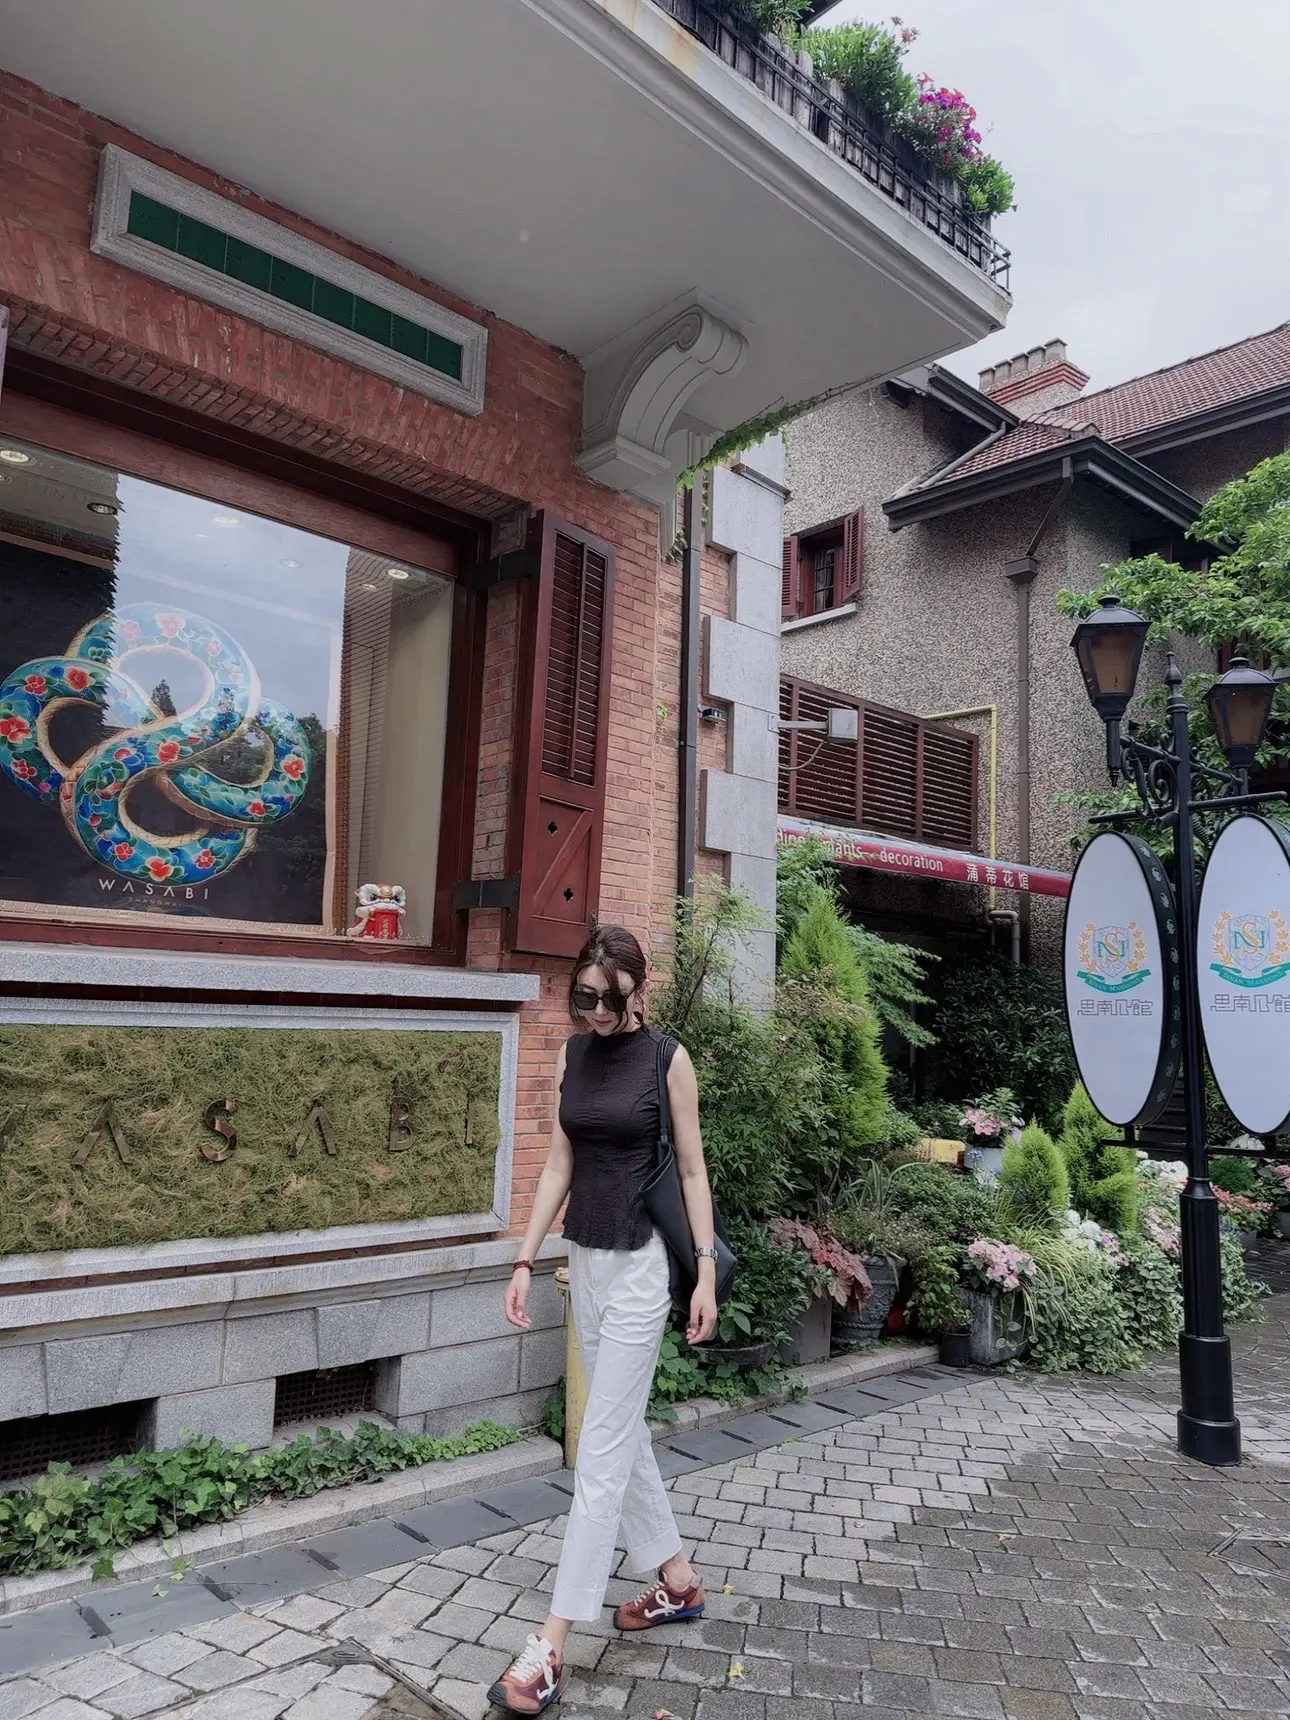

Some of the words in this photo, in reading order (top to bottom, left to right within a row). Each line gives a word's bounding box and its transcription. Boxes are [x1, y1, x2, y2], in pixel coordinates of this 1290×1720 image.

[822, 837, 862, 858] lants
[880, 847, 943, 872] decoration
[98, 879, 208, 899] WASABI
[966, 862, 1029, 890] 蒲蒂花馆
[0, 1095, 473, 1167] ASABI
